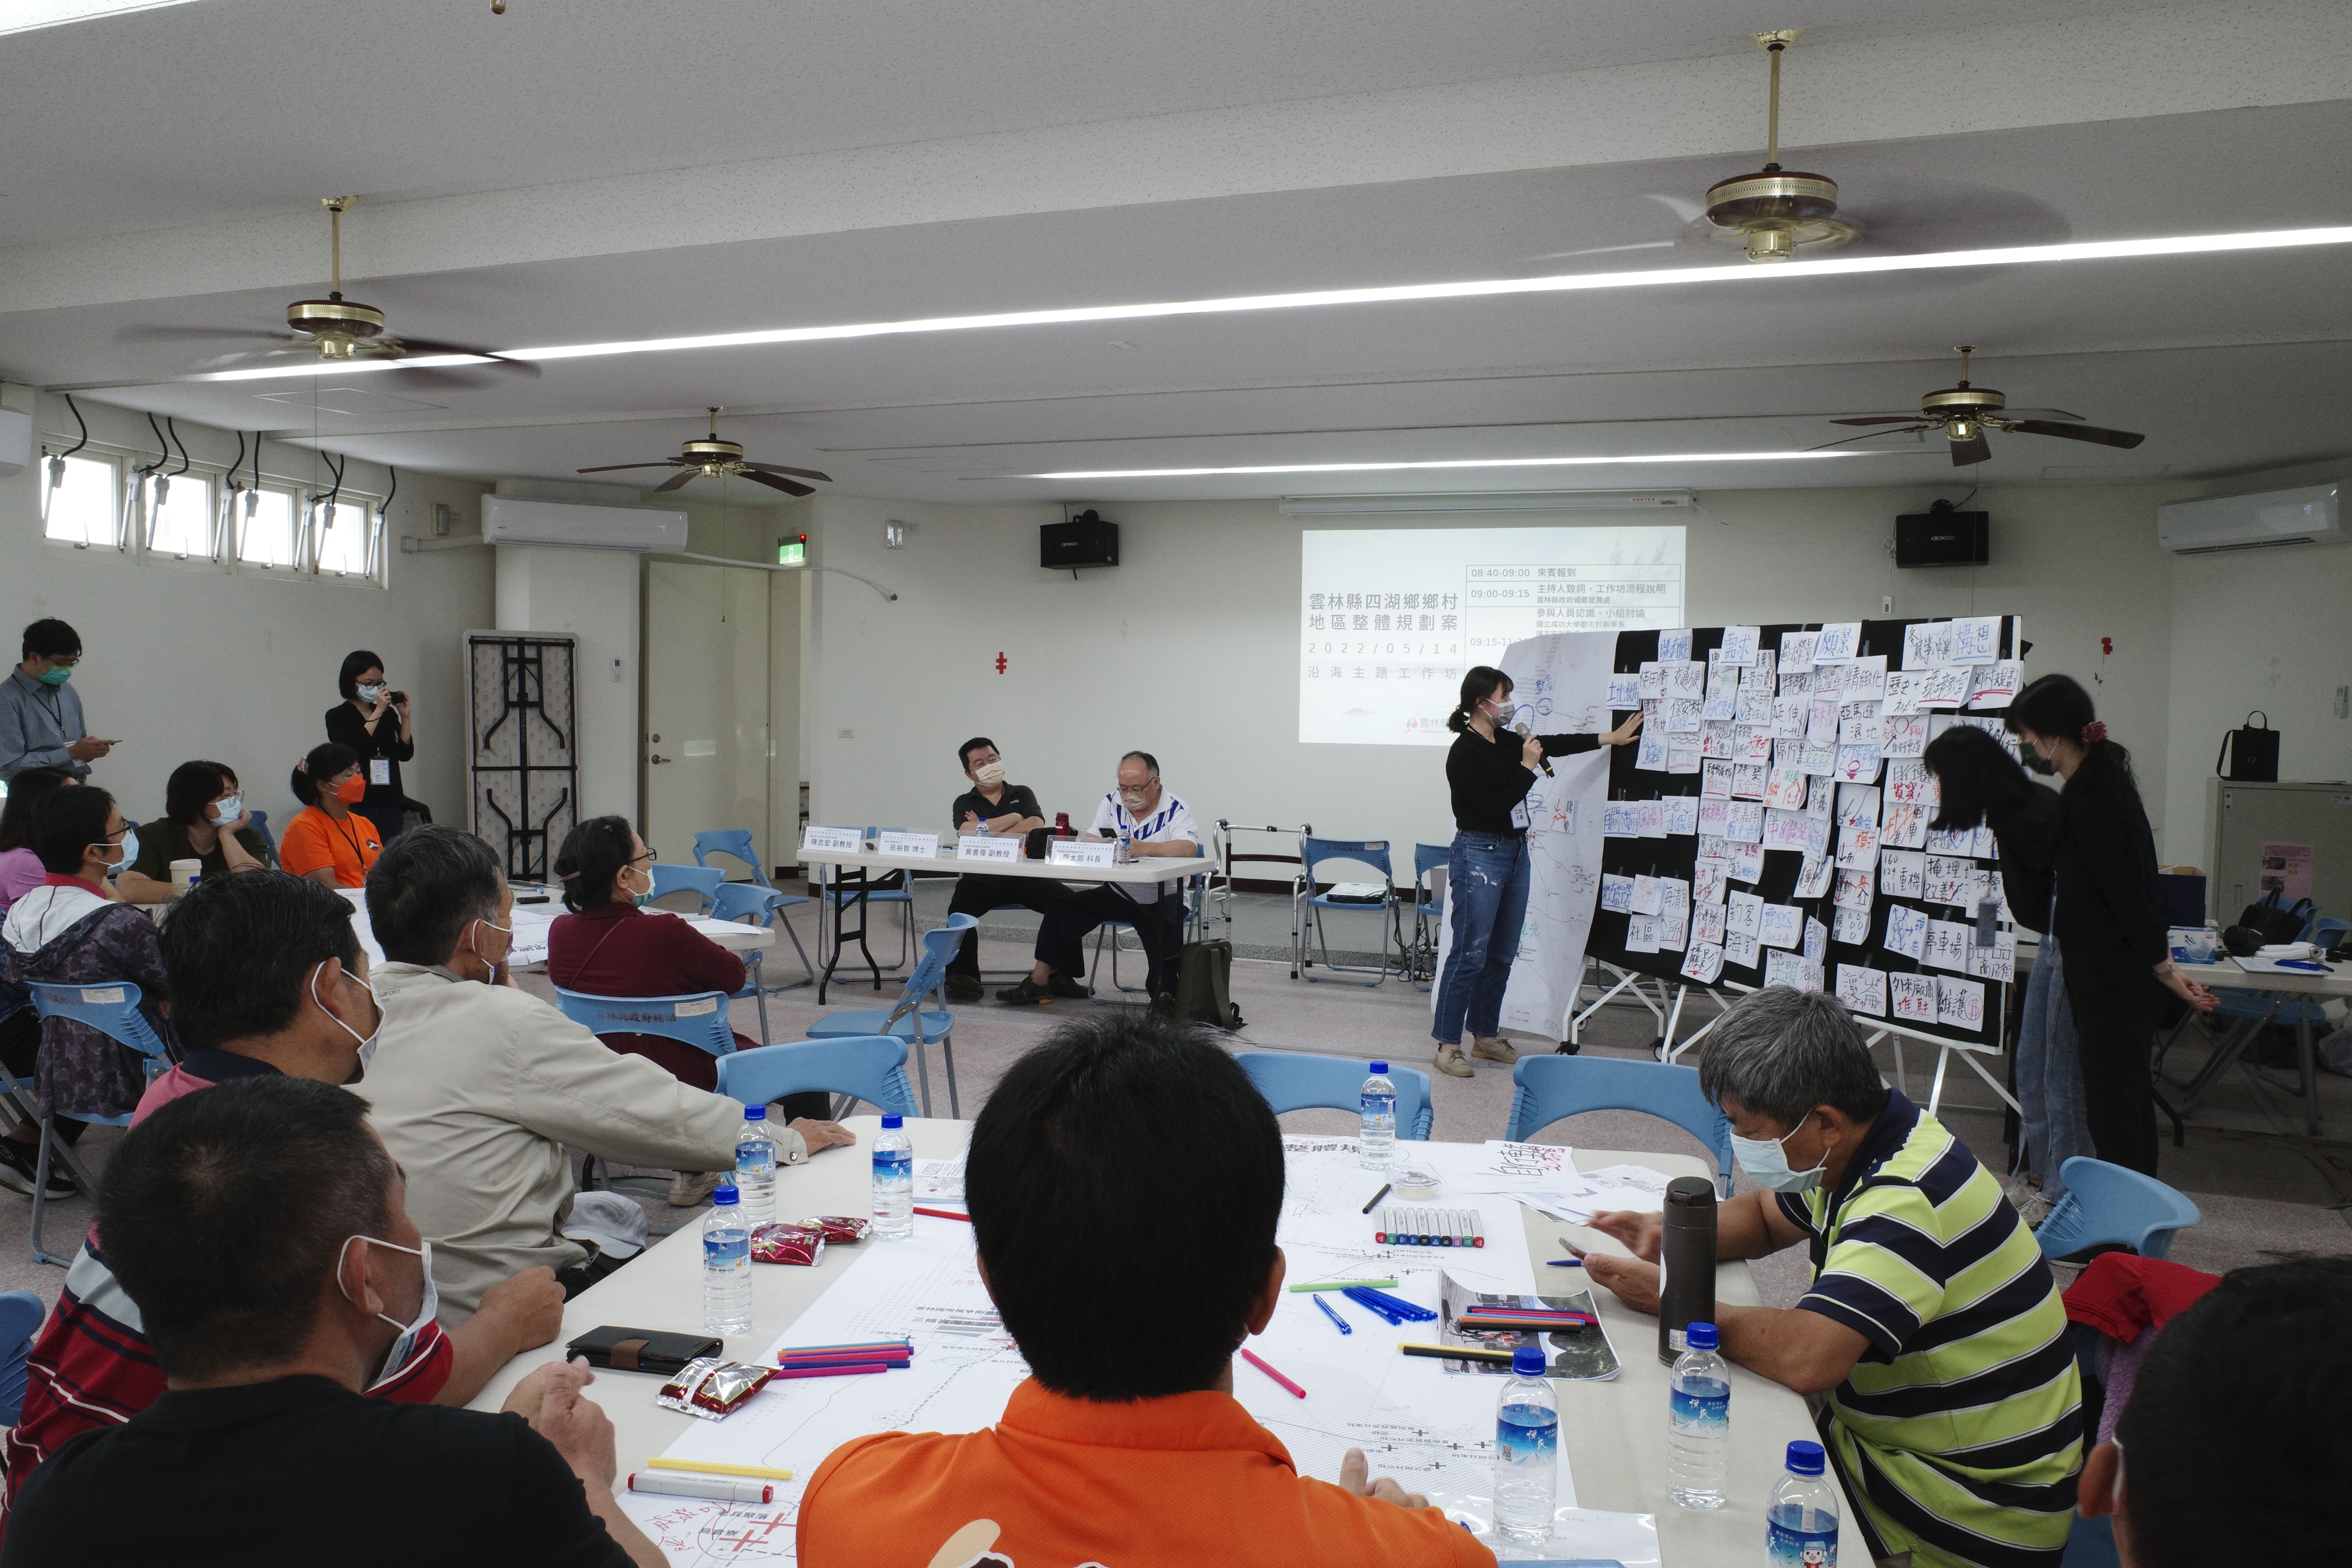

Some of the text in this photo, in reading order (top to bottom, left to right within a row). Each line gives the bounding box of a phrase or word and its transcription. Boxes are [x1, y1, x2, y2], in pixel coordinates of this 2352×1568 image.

[1471, 569, 1530, 577] 08:40-09:00
[1537, 568, 1576, 577] 來賓報到
[1471, 590, 1530, 598] 09:00-09:15
[1537, 583, 1666, 594] 主持人致詞、工作坊流程說明
[1309, 593, 1458, 610] 雲林縣四湖鄉鄉村
[1536, 596, 1611, 604] 雲林縣政府城鄉發展處
[1536, 608, 1645, 618] 參與人員認識、小組討論
[1309, 614, 1458, 631] 地區整體規劃案
[1536, 620, 1625, 628] 國立成功大學都市計劃學系
[1817, 628, 1852, 657] 願景
[1952, 621, 1991, 656] 構想
[1308, 666, 1457, 680] 沿海主題工作坊
[1844, 666, 1882, 692] 精緻化
[1771, 704, 1799, 724] 延伸
[1840, 703, 1875, 720] 亞馬遜
[1893, 764, 1932, 784] 自行車
[811, 838, 853, 848] 陳志宏 副教授
[965, 848, 1010, 858] 黃書偉 副教授
[1063, 853, 1084, 862] 周太郎
[1629, 921, 1654, 942] 社區
[377, 989, 400, 997] cardin
